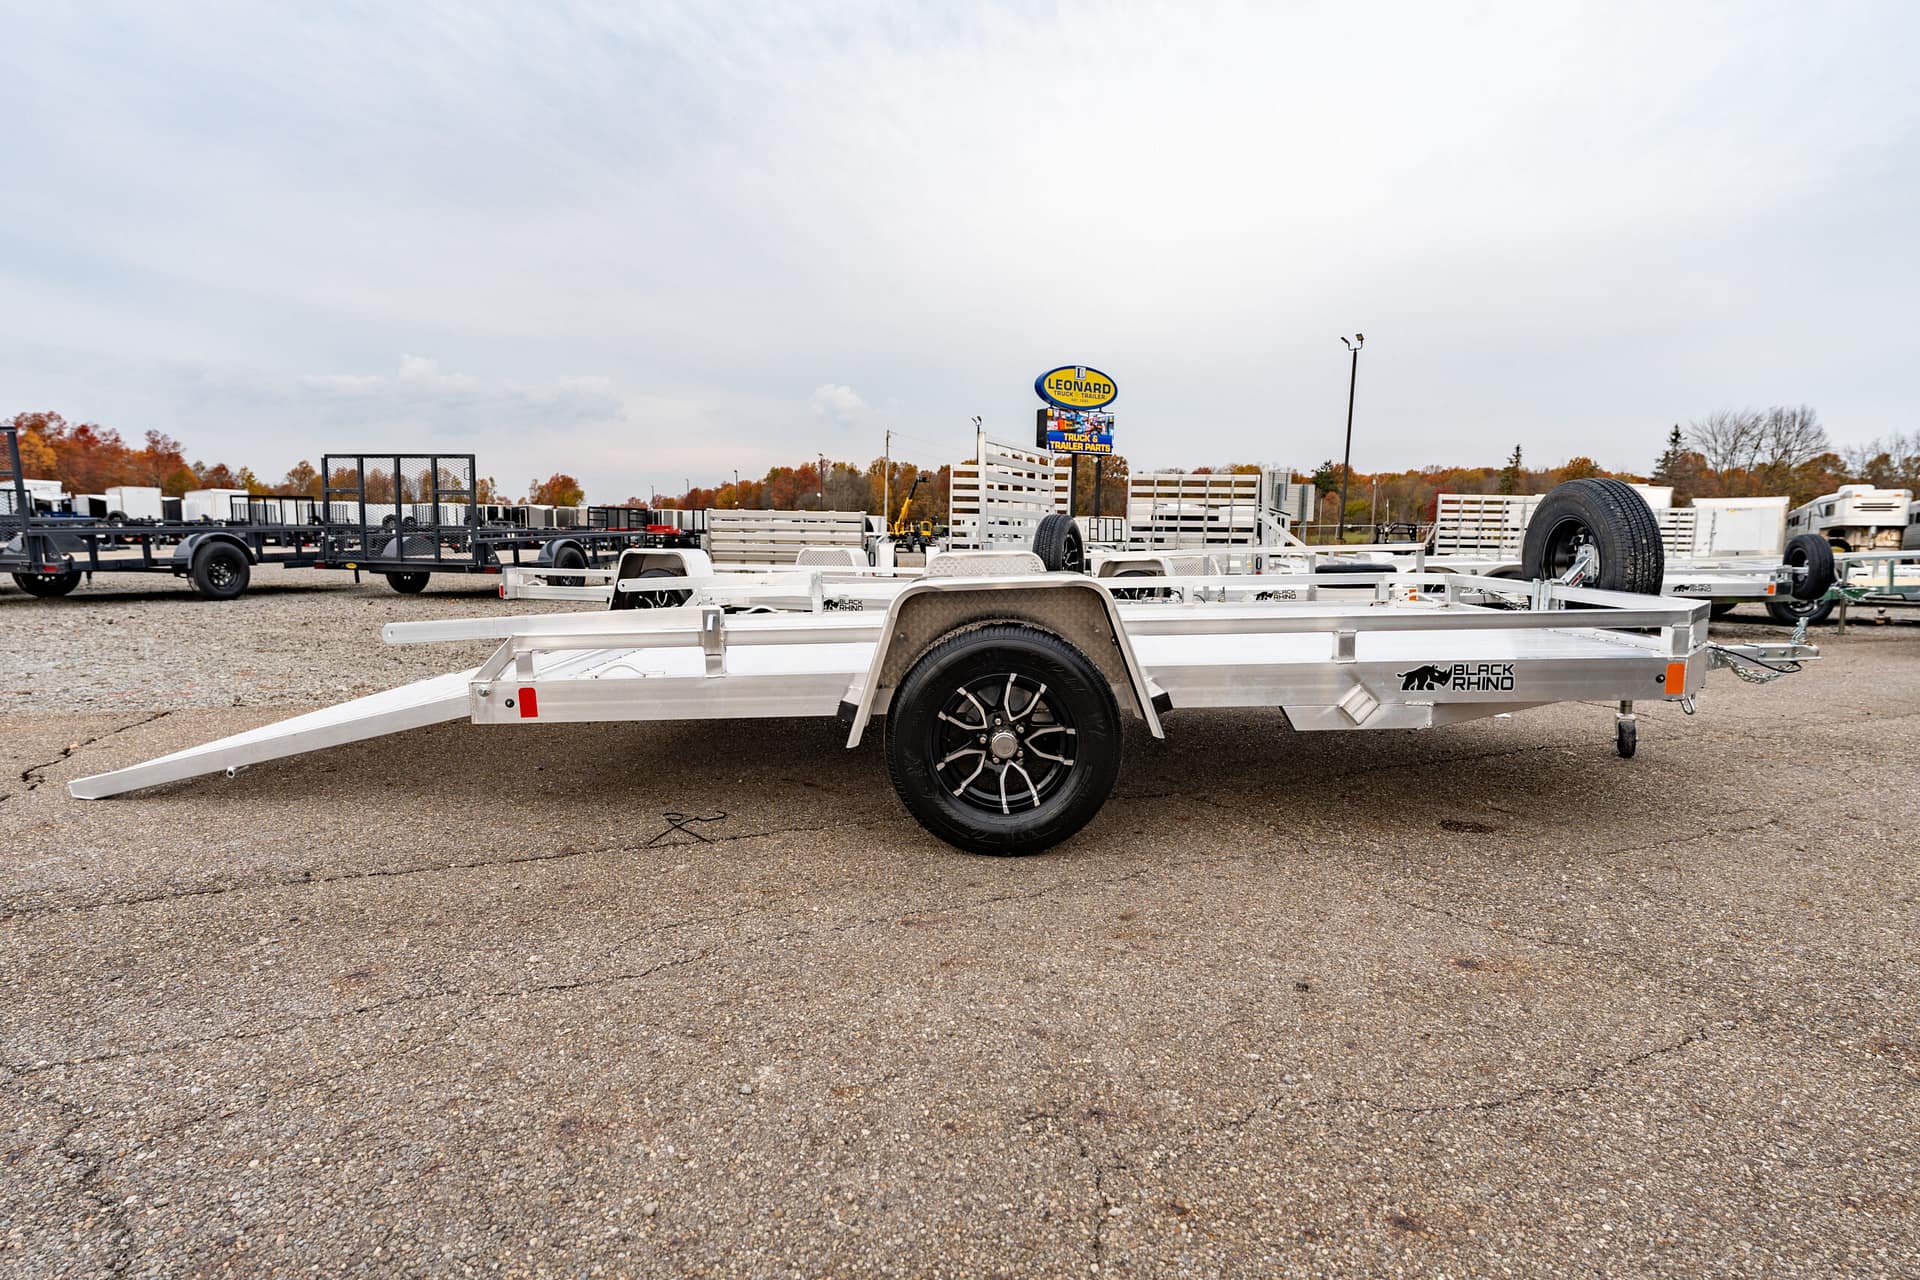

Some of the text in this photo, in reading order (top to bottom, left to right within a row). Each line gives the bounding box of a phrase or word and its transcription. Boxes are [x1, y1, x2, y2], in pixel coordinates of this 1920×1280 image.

[1048, 378, 1111, 394] LEONARD
[1081, 392, 1106, 400] TRAILER
[1063, 433, 1090, 442] TRUCK
[1050, 441, 1111, 452] TRAILER PARTS
[1453, 663, 1514, 676] BLACK
[1452, 676, 1514, 691] RHINO
